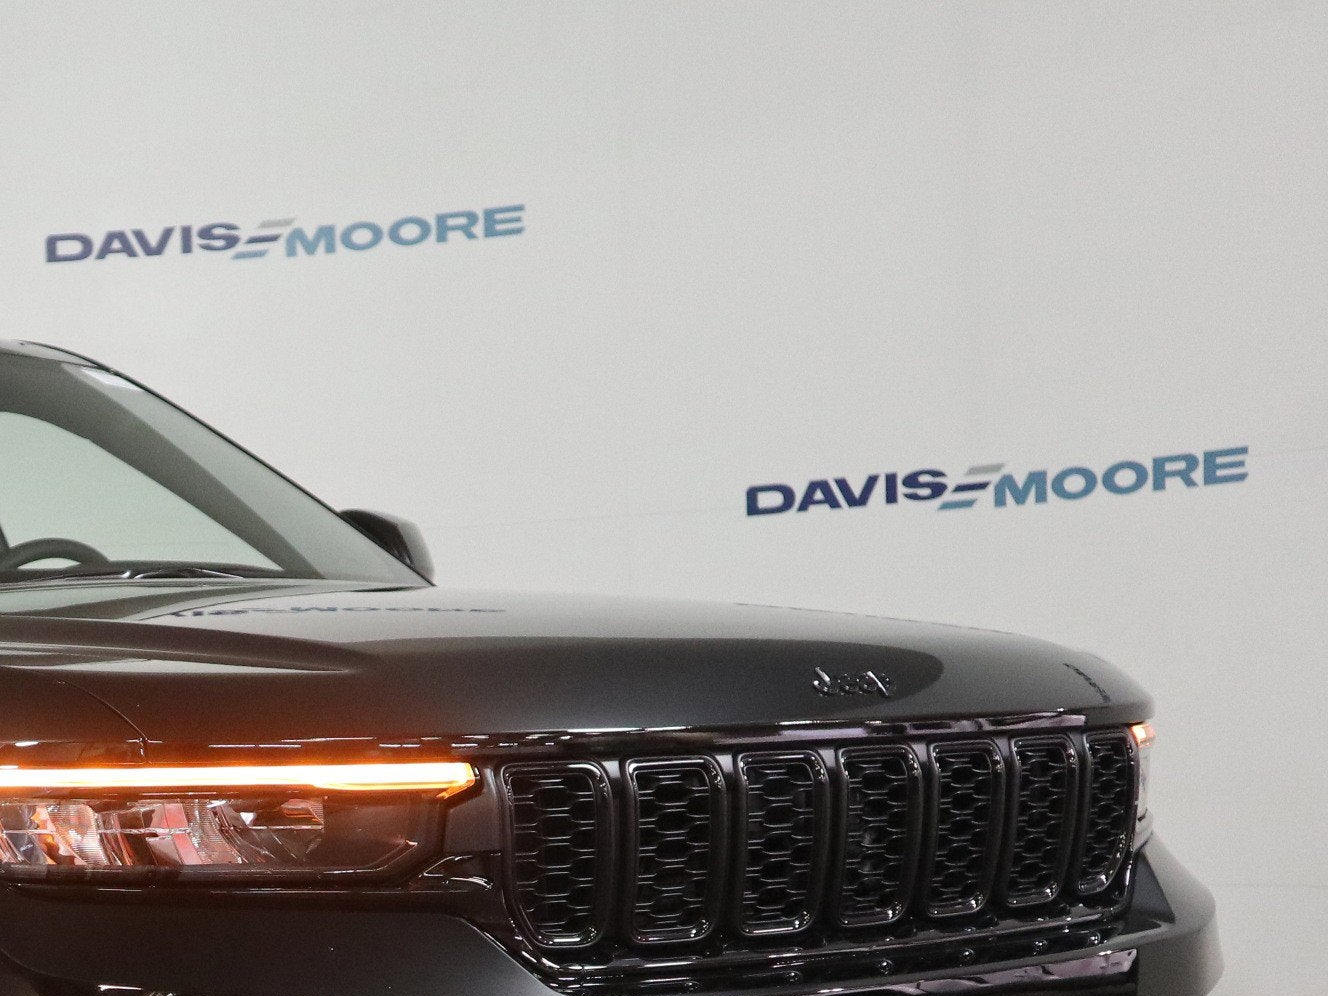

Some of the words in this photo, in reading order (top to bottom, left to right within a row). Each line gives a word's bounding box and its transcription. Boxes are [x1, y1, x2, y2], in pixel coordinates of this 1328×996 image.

[44, 223, 241, 264] DAVIS
[285, 204, 526, 259] MOORE
[745, 468, 950, 517] DAVIS
[993, 445, 1250, 509] MOORE
